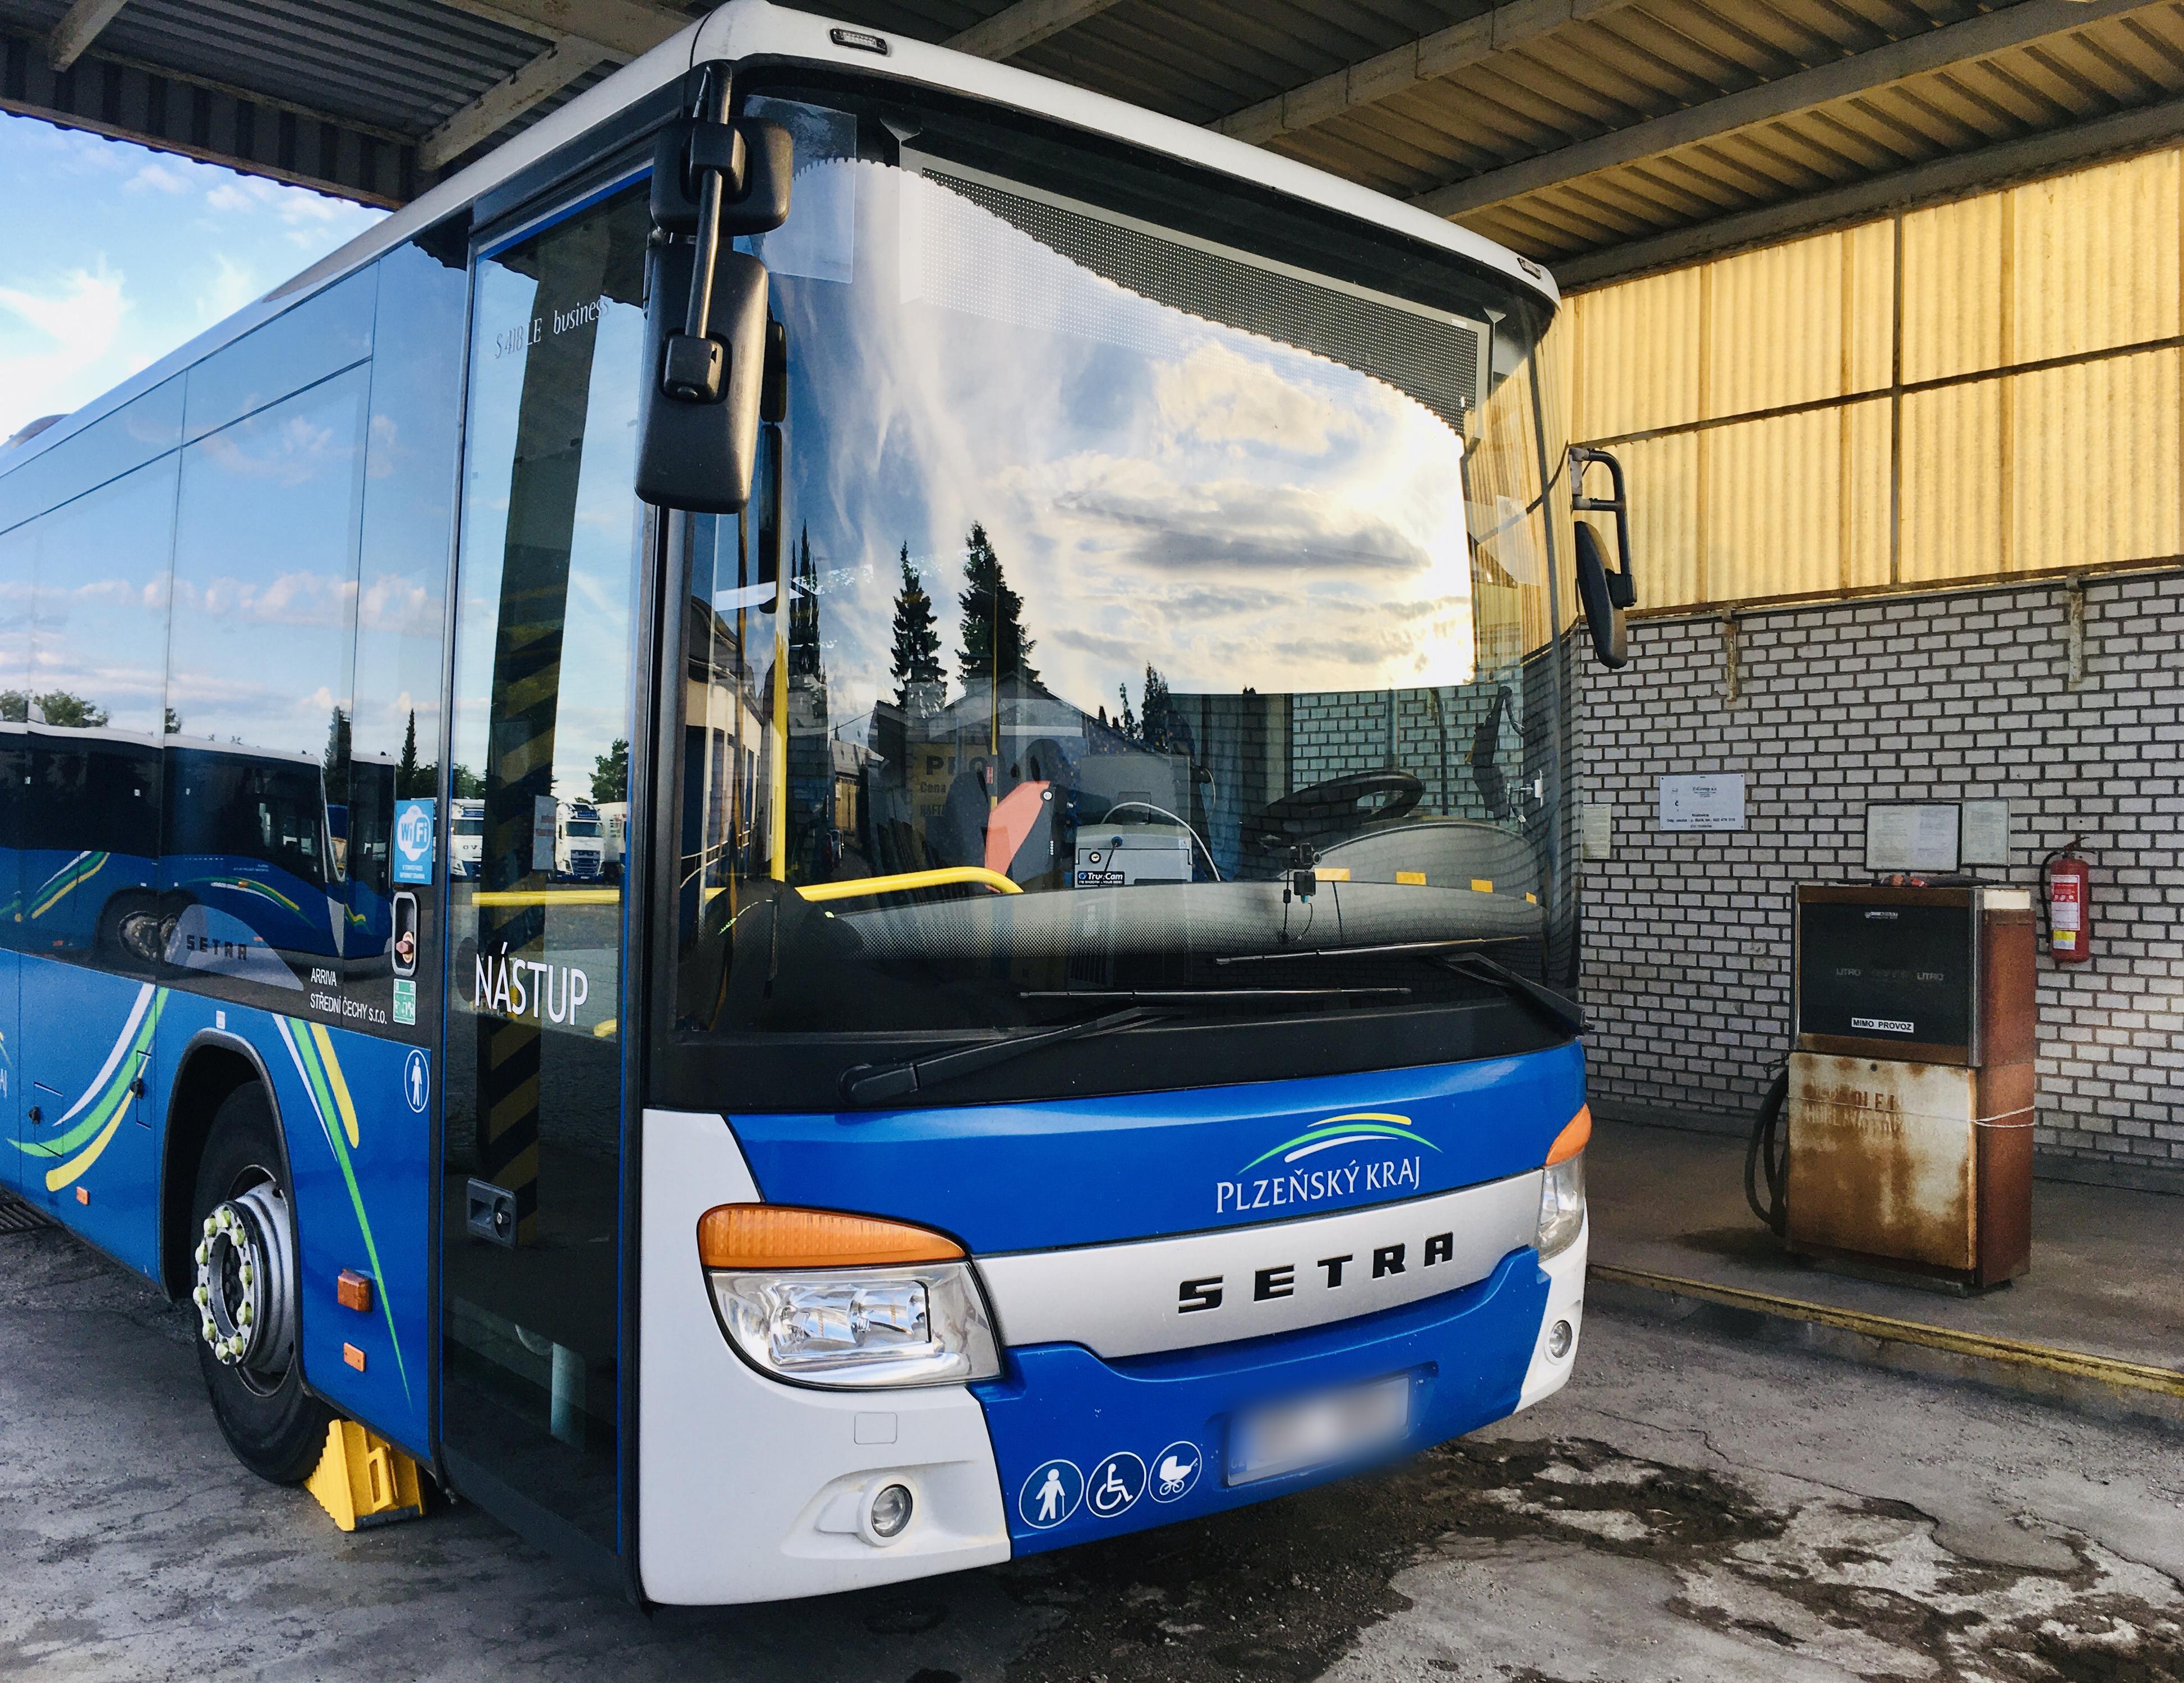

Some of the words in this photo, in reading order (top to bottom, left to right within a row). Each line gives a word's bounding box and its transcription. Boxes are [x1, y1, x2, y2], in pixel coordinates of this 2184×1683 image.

[495, 333, 503, 358] S
[505, 325, 523, 354] 418
[527, 318, 542, 346] LE
[553, 299, 609, 335] business
[187, 935, 246, 960] SETRA
[310, 968, 337, 987] ARRIVA
[475, 941, 588, 1026] NÁSTUP
[310, 991, 342, 1014] STŘEDNÍ
[342, 996, 367, 1019] ČECHY
[368, 1008, 387, 1024] s.r.o.
[1878, 1022, 1912, 1031] PROVOZ
[1216, 1159, 1360, 1213] PLZEŇSKÝ
[1366, 1156, 1420, 1190] KRAJ
[1178, 1231, 1454, 1314] SETRA
